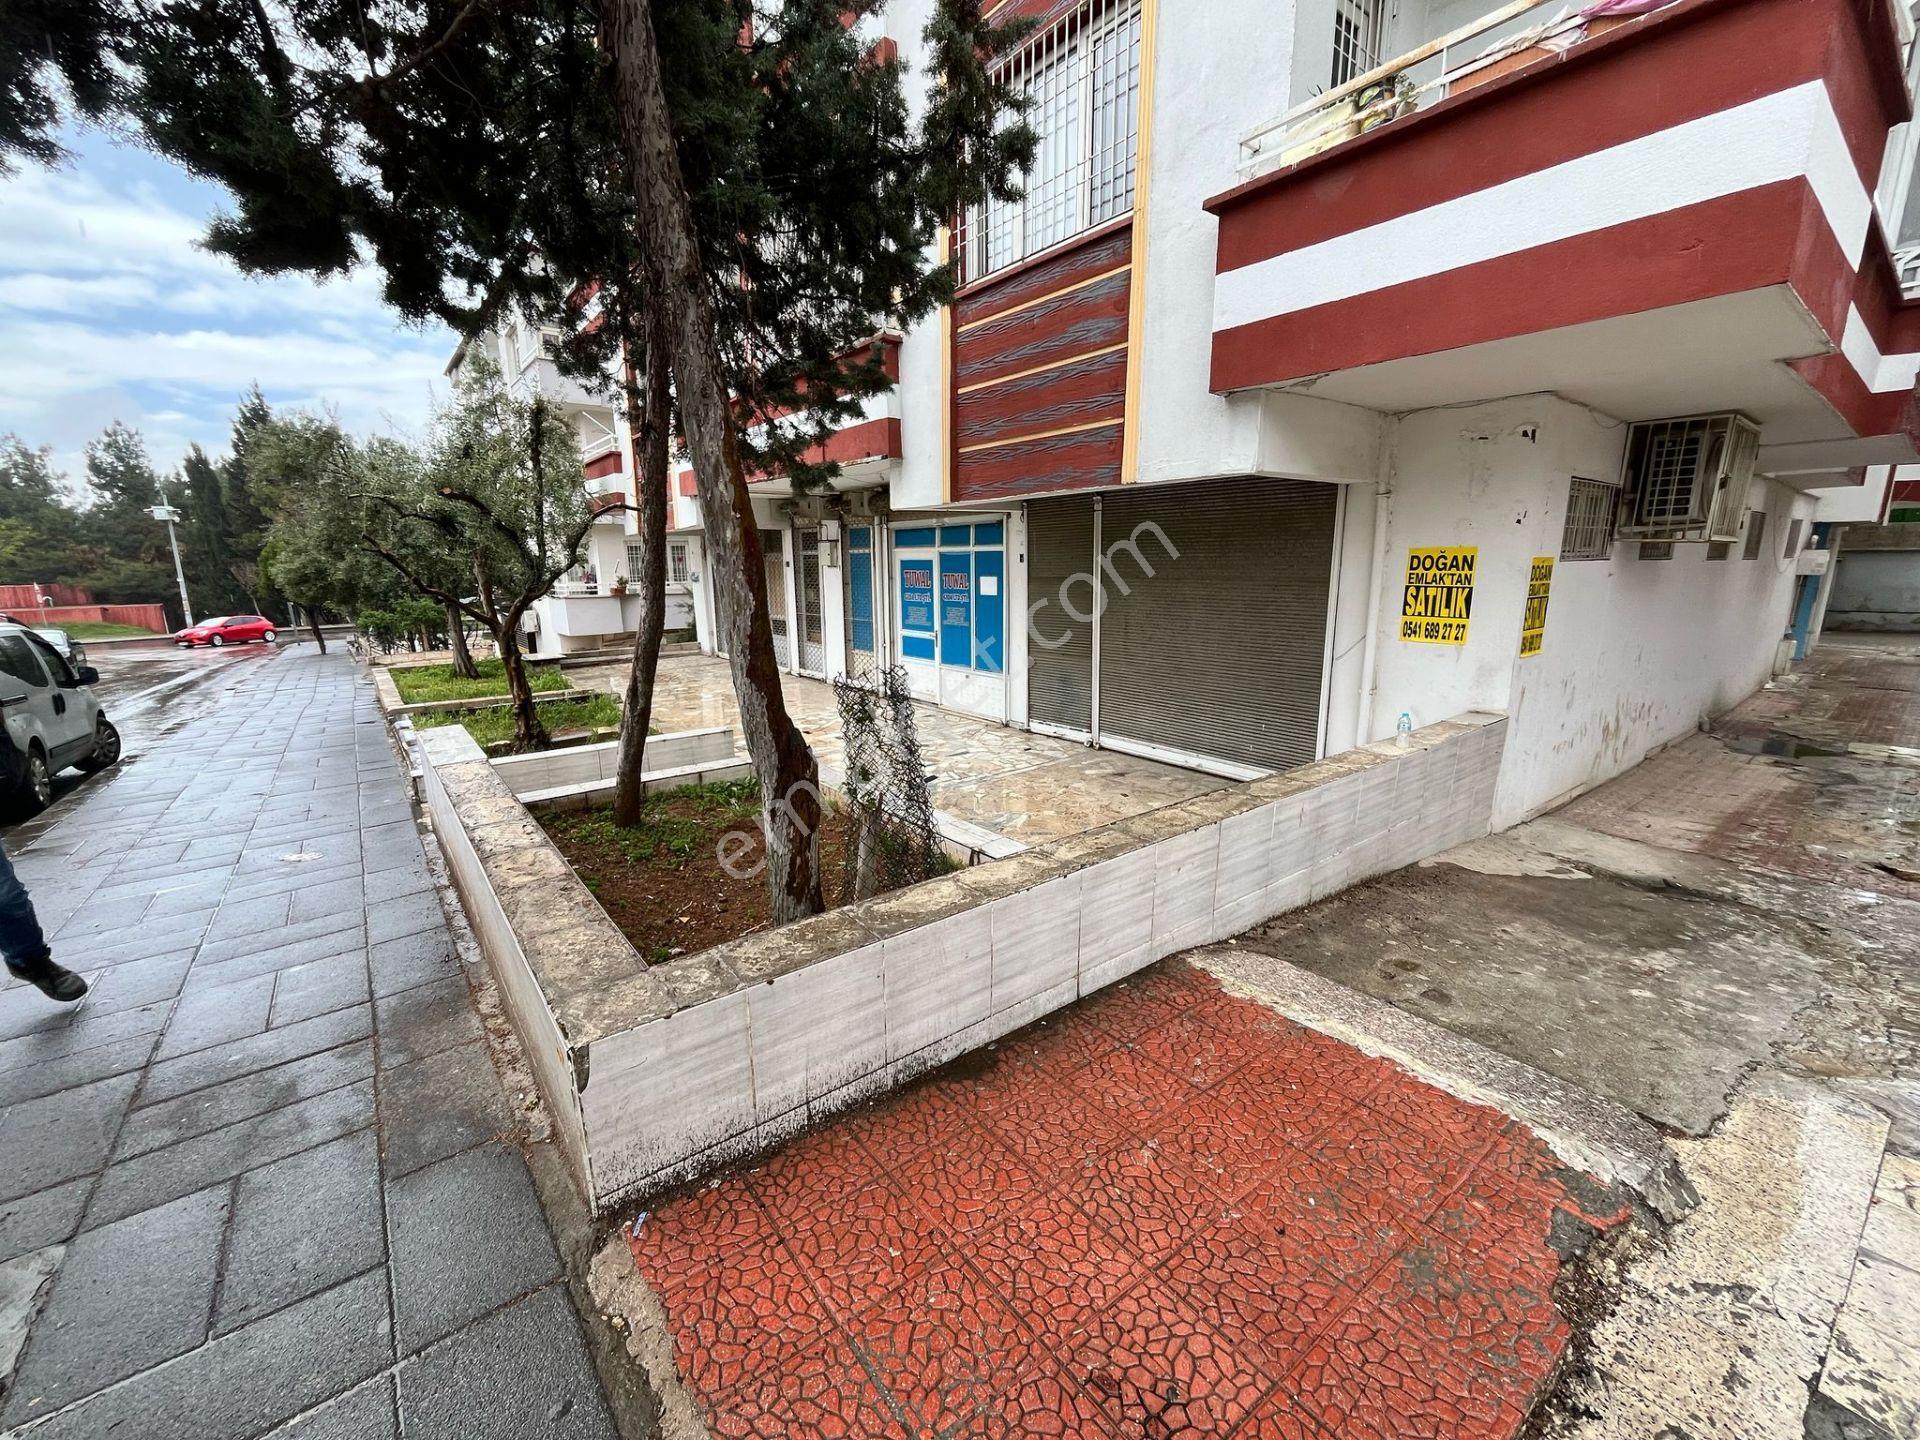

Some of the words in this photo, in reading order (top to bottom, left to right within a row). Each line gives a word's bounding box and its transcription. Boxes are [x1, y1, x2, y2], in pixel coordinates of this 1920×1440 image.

[1409, 549, 1475, 571] DOĞAN
[1404, 586, 1470, 618] SATILIK
[1402, 621, 1421, 638] 0541
[1424, 621, 1440, 640] 689
[1441, 622, 1453, 641] 27
[1454, 623, 1466, 642] 27
